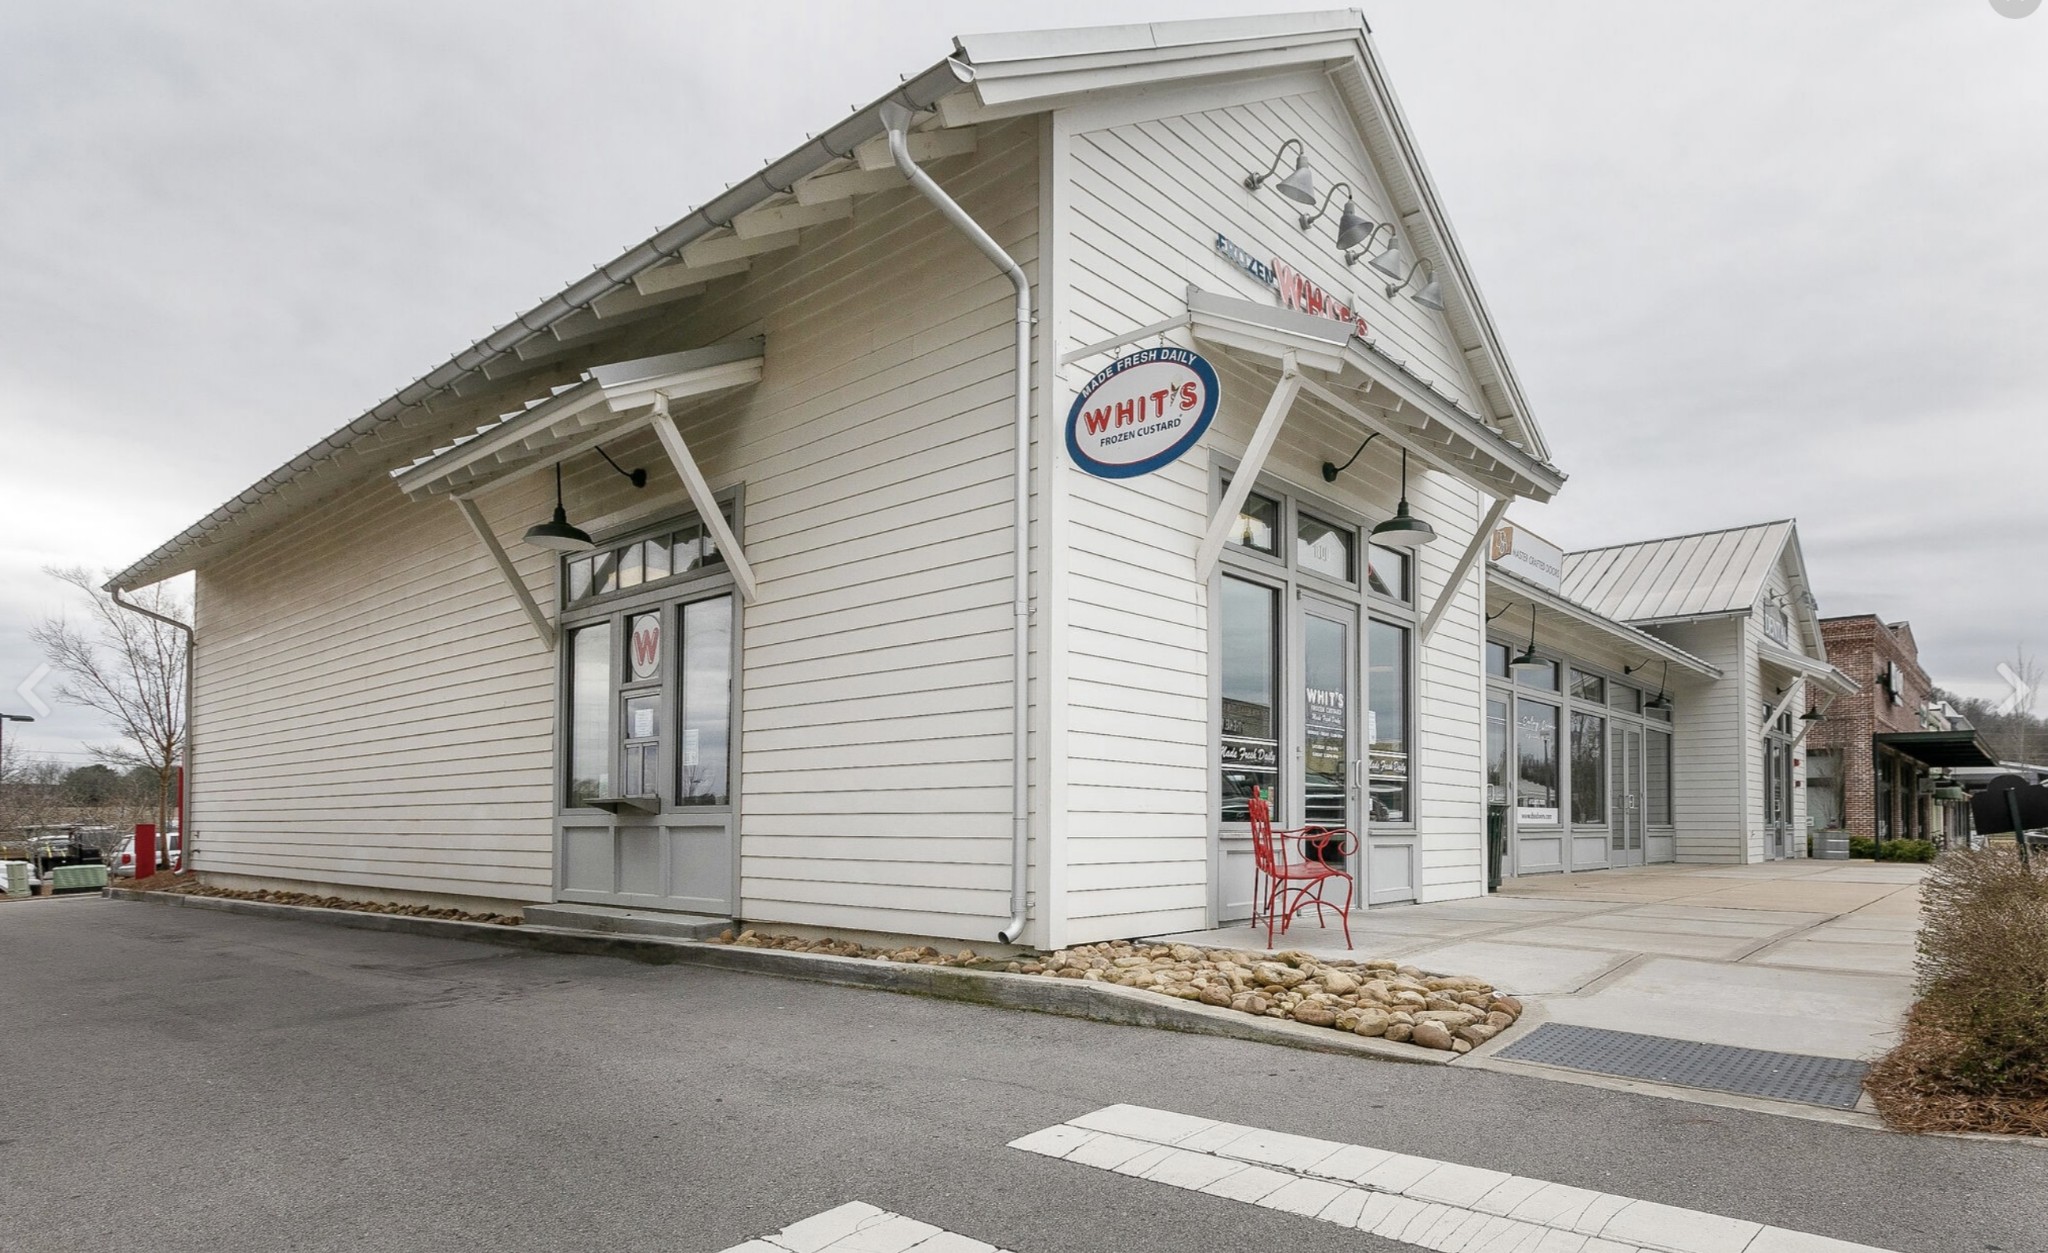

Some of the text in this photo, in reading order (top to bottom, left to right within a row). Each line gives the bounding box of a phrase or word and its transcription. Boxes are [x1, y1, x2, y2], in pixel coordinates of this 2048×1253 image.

[1216, 232, 1275, 287] FROZEN
[1081, 349, 1198, 399] MADE FRESH DAILY
[1084, 381, 1198, 436] WHIT'S
[1100, 418, 1182, 448] FROZEN CUSTARD
[633, 627, 659, 666] W
[1306, 687, 1344, 709] WHIT'S
[1239, 747, 1257, 761] Fresh
[1258, 748, 1276, 765] Daily
